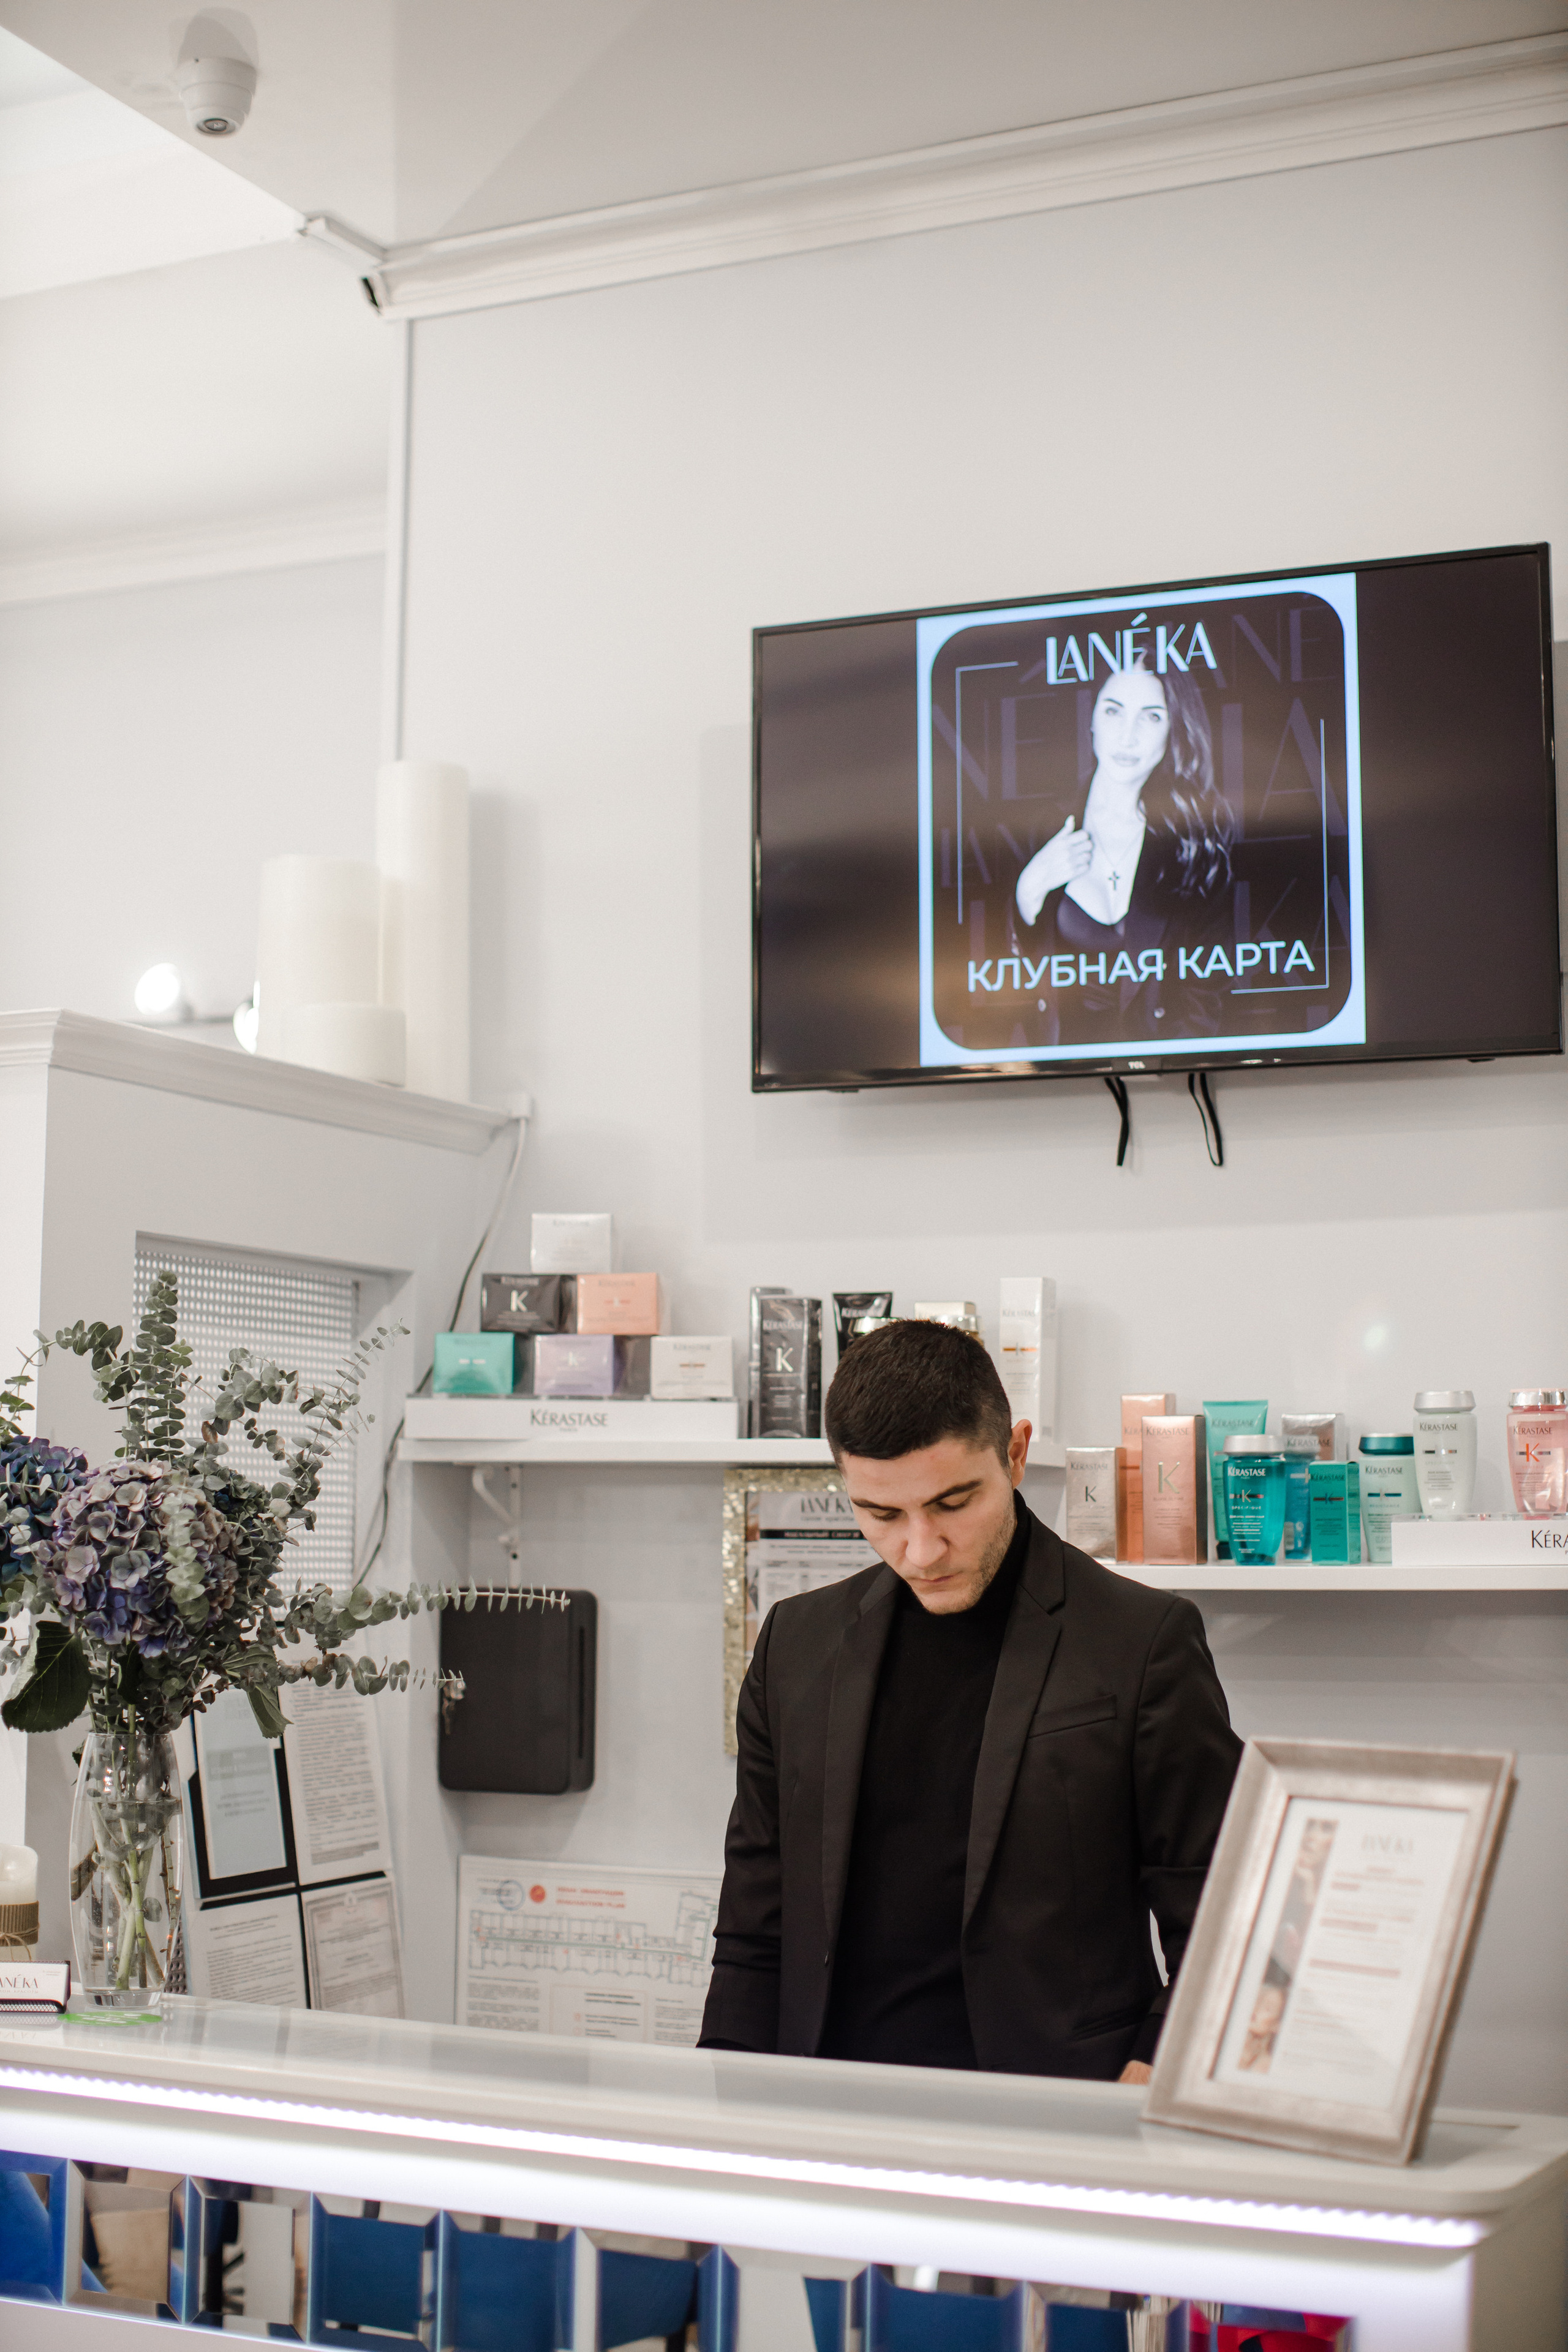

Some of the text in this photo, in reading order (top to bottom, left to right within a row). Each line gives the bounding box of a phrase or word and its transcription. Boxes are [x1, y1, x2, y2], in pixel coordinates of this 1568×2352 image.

[1046, 612, 1218, 685] LANÉKA
[968, 940, 1316, 993] КЛУБНАЯ КАРТА
[1128, 1061, 1146, 1070] TCL
[775, 1347, 794, 1373] K
[530, 1408, 608, 1427] KÉRASTASE
[1419, 1422, 1458, 1431] KÉRASTASE
[1513, 1425, 1553, 1435] KÉRASTASE
[1526, 1442, 1540, 1463] K
[1158, 1461, 1181, 1494] K
[1227, 1466, 1267, 1477] KÉRASTASE
[1085, 1485, 1097, 1502] K
[1242, 1489, 1251, 1503] K
